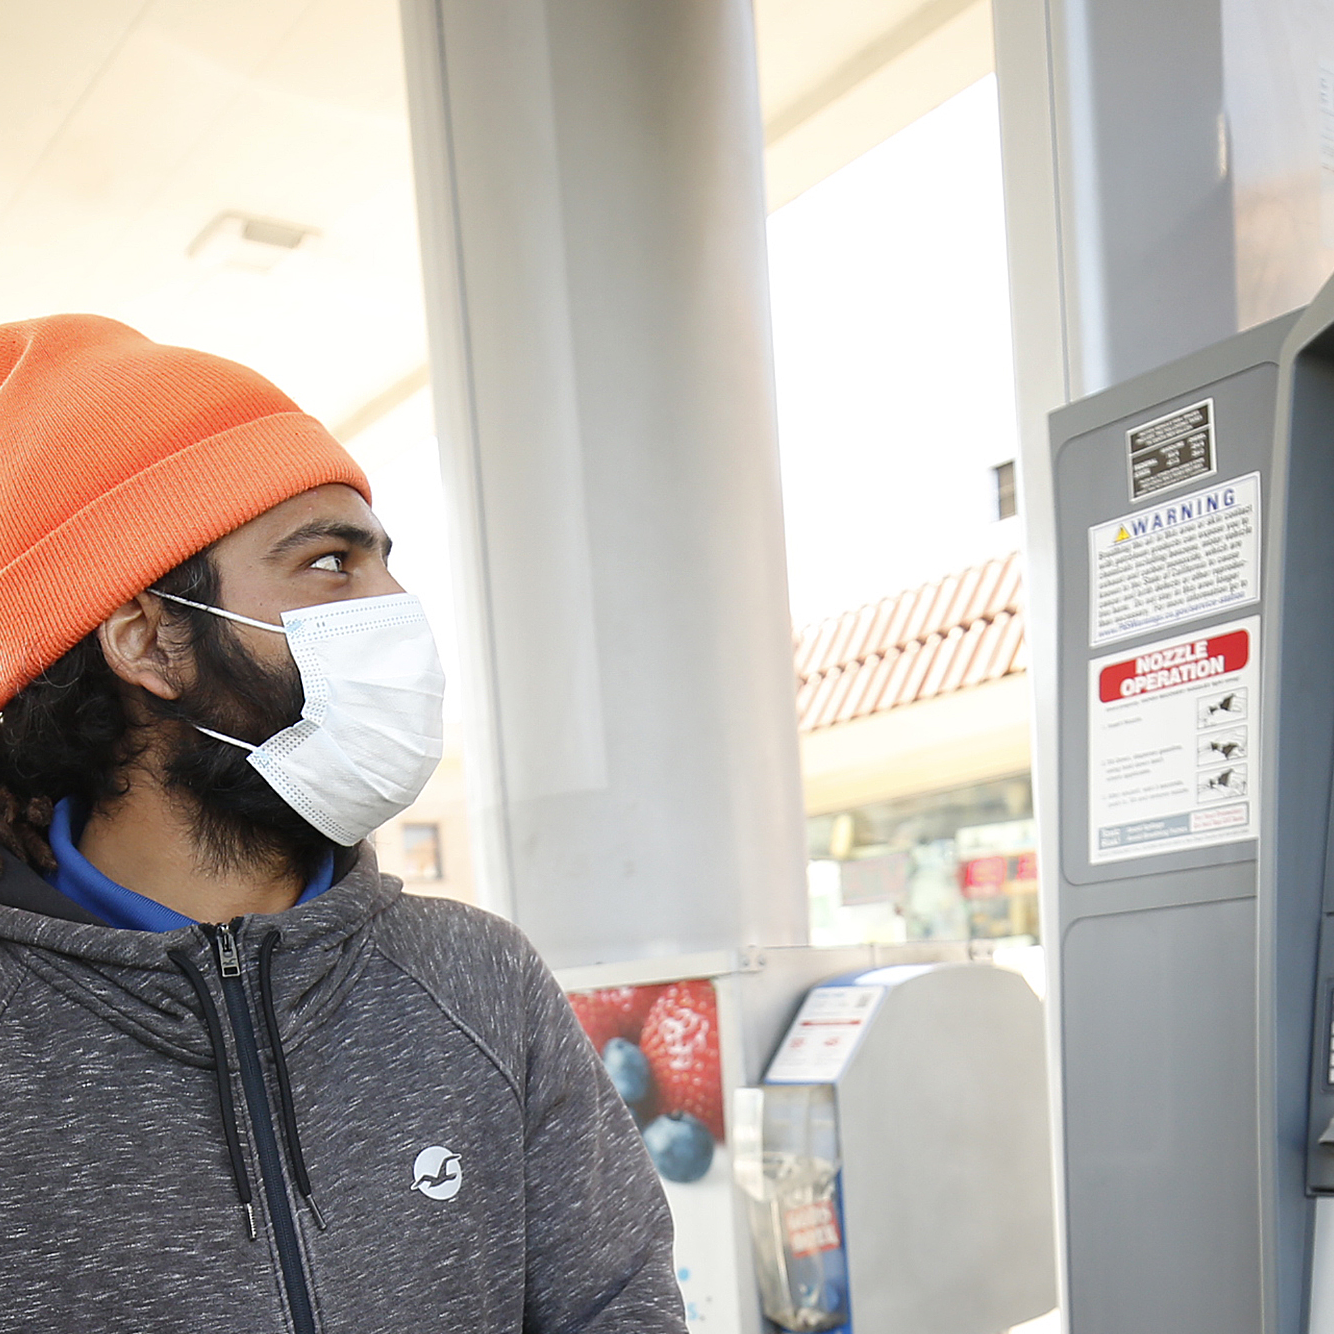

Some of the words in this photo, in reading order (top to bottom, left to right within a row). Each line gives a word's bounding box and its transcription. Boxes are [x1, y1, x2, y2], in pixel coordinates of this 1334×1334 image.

[1131, 488, 1235, 536] WARNING
[1120, 655, 1224, 697] OPERATION
[1135, 640, 1208, 675] NOZZLE
